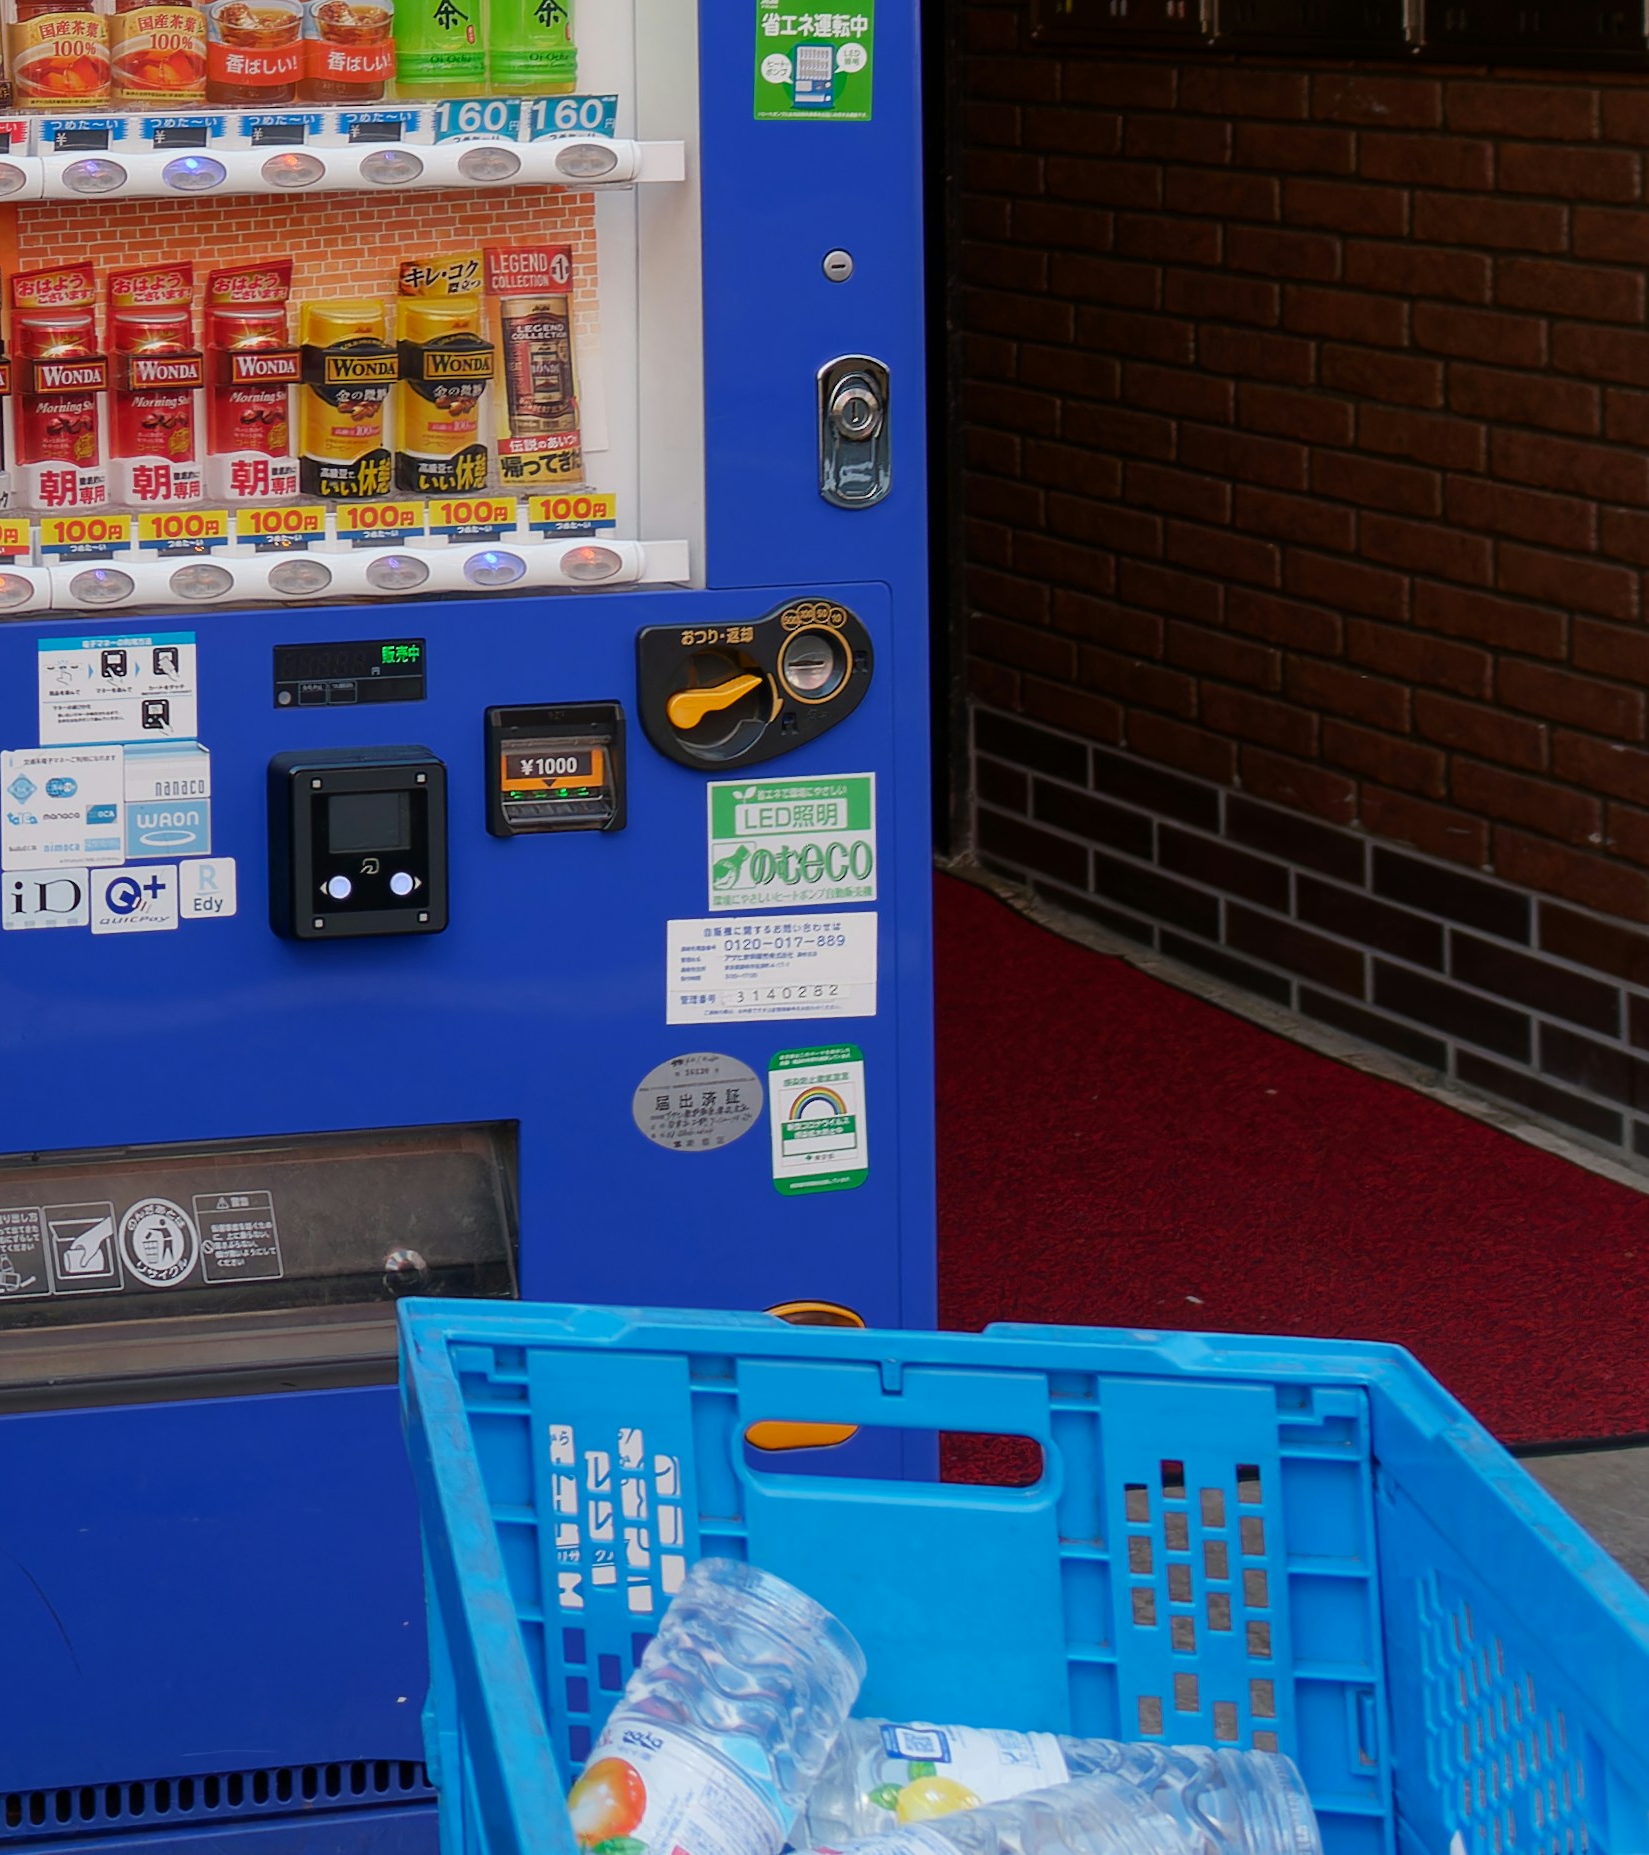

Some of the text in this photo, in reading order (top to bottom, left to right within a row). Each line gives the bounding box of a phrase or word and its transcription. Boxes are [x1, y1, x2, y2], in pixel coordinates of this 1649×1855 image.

[39, 20, 99, 37] 国産茶葉
[761, 13, 868, 37] 省エネ運転中
[224, 53, 298, 76] 香ばしい!
[489, 253, 548, 271] LEGEND
[214, 275, 278, 296] おはよう
[490, 273, 549, 289] COLLECTION
[138, 359, 198, 383] WONDA
[682, 628, 754, 645] おつり・返却
[382, 645, 420, 664] 販売中
[521, 756, 578, 776] ¥1000
[744, 805, 839, 830] LED照明
[750, 840, 873, 885] のむeco
[723, 934, 846, 951] 0120-017-889
[736, 984, 839, 1002] 3140282
